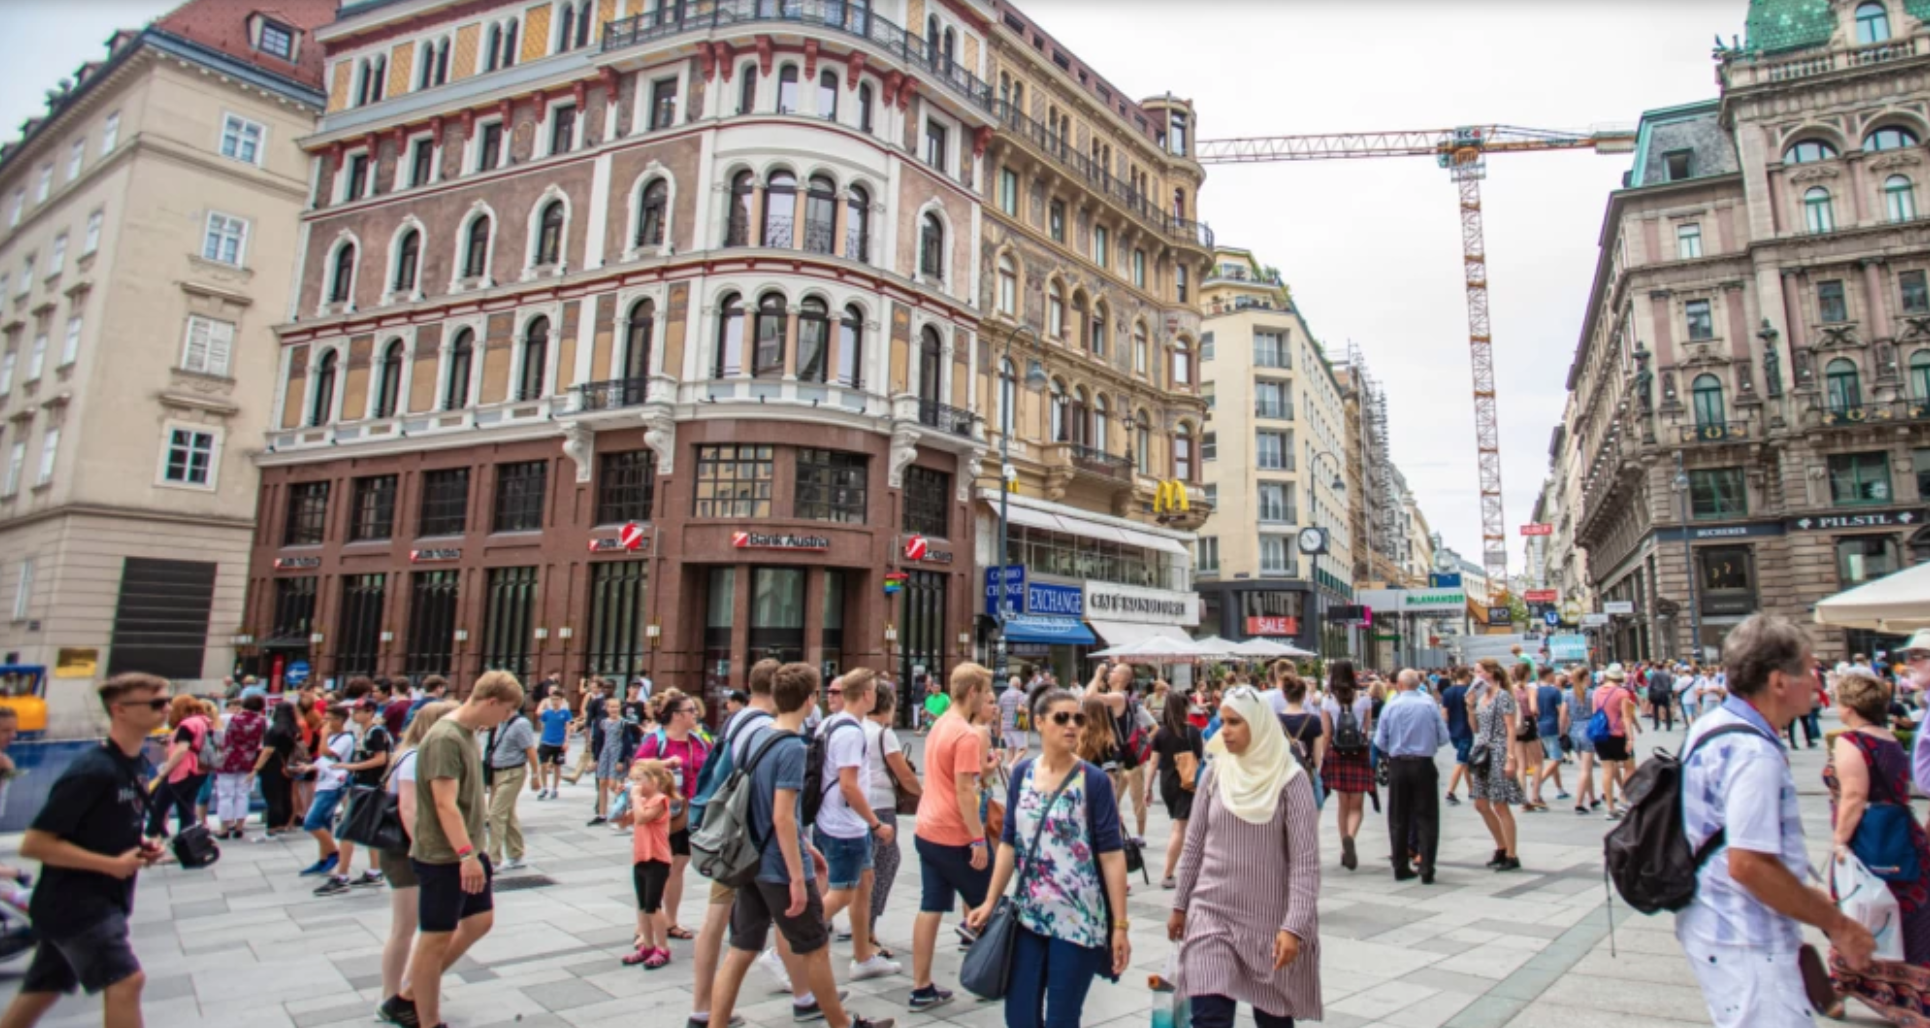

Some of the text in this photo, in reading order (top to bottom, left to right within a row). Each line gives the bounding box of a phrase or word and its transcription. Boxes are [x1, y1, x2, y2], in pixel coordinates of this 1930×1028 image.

[1820, 514, 1892, 528] PILSTL
[749, 532, 830, 548] Bank Austria
[1697, 527, 1747, 537] BUCHERER
[1029, 586, 1082, 614] EXCHANGE
[1257, 617, 1287, 633] SALE
